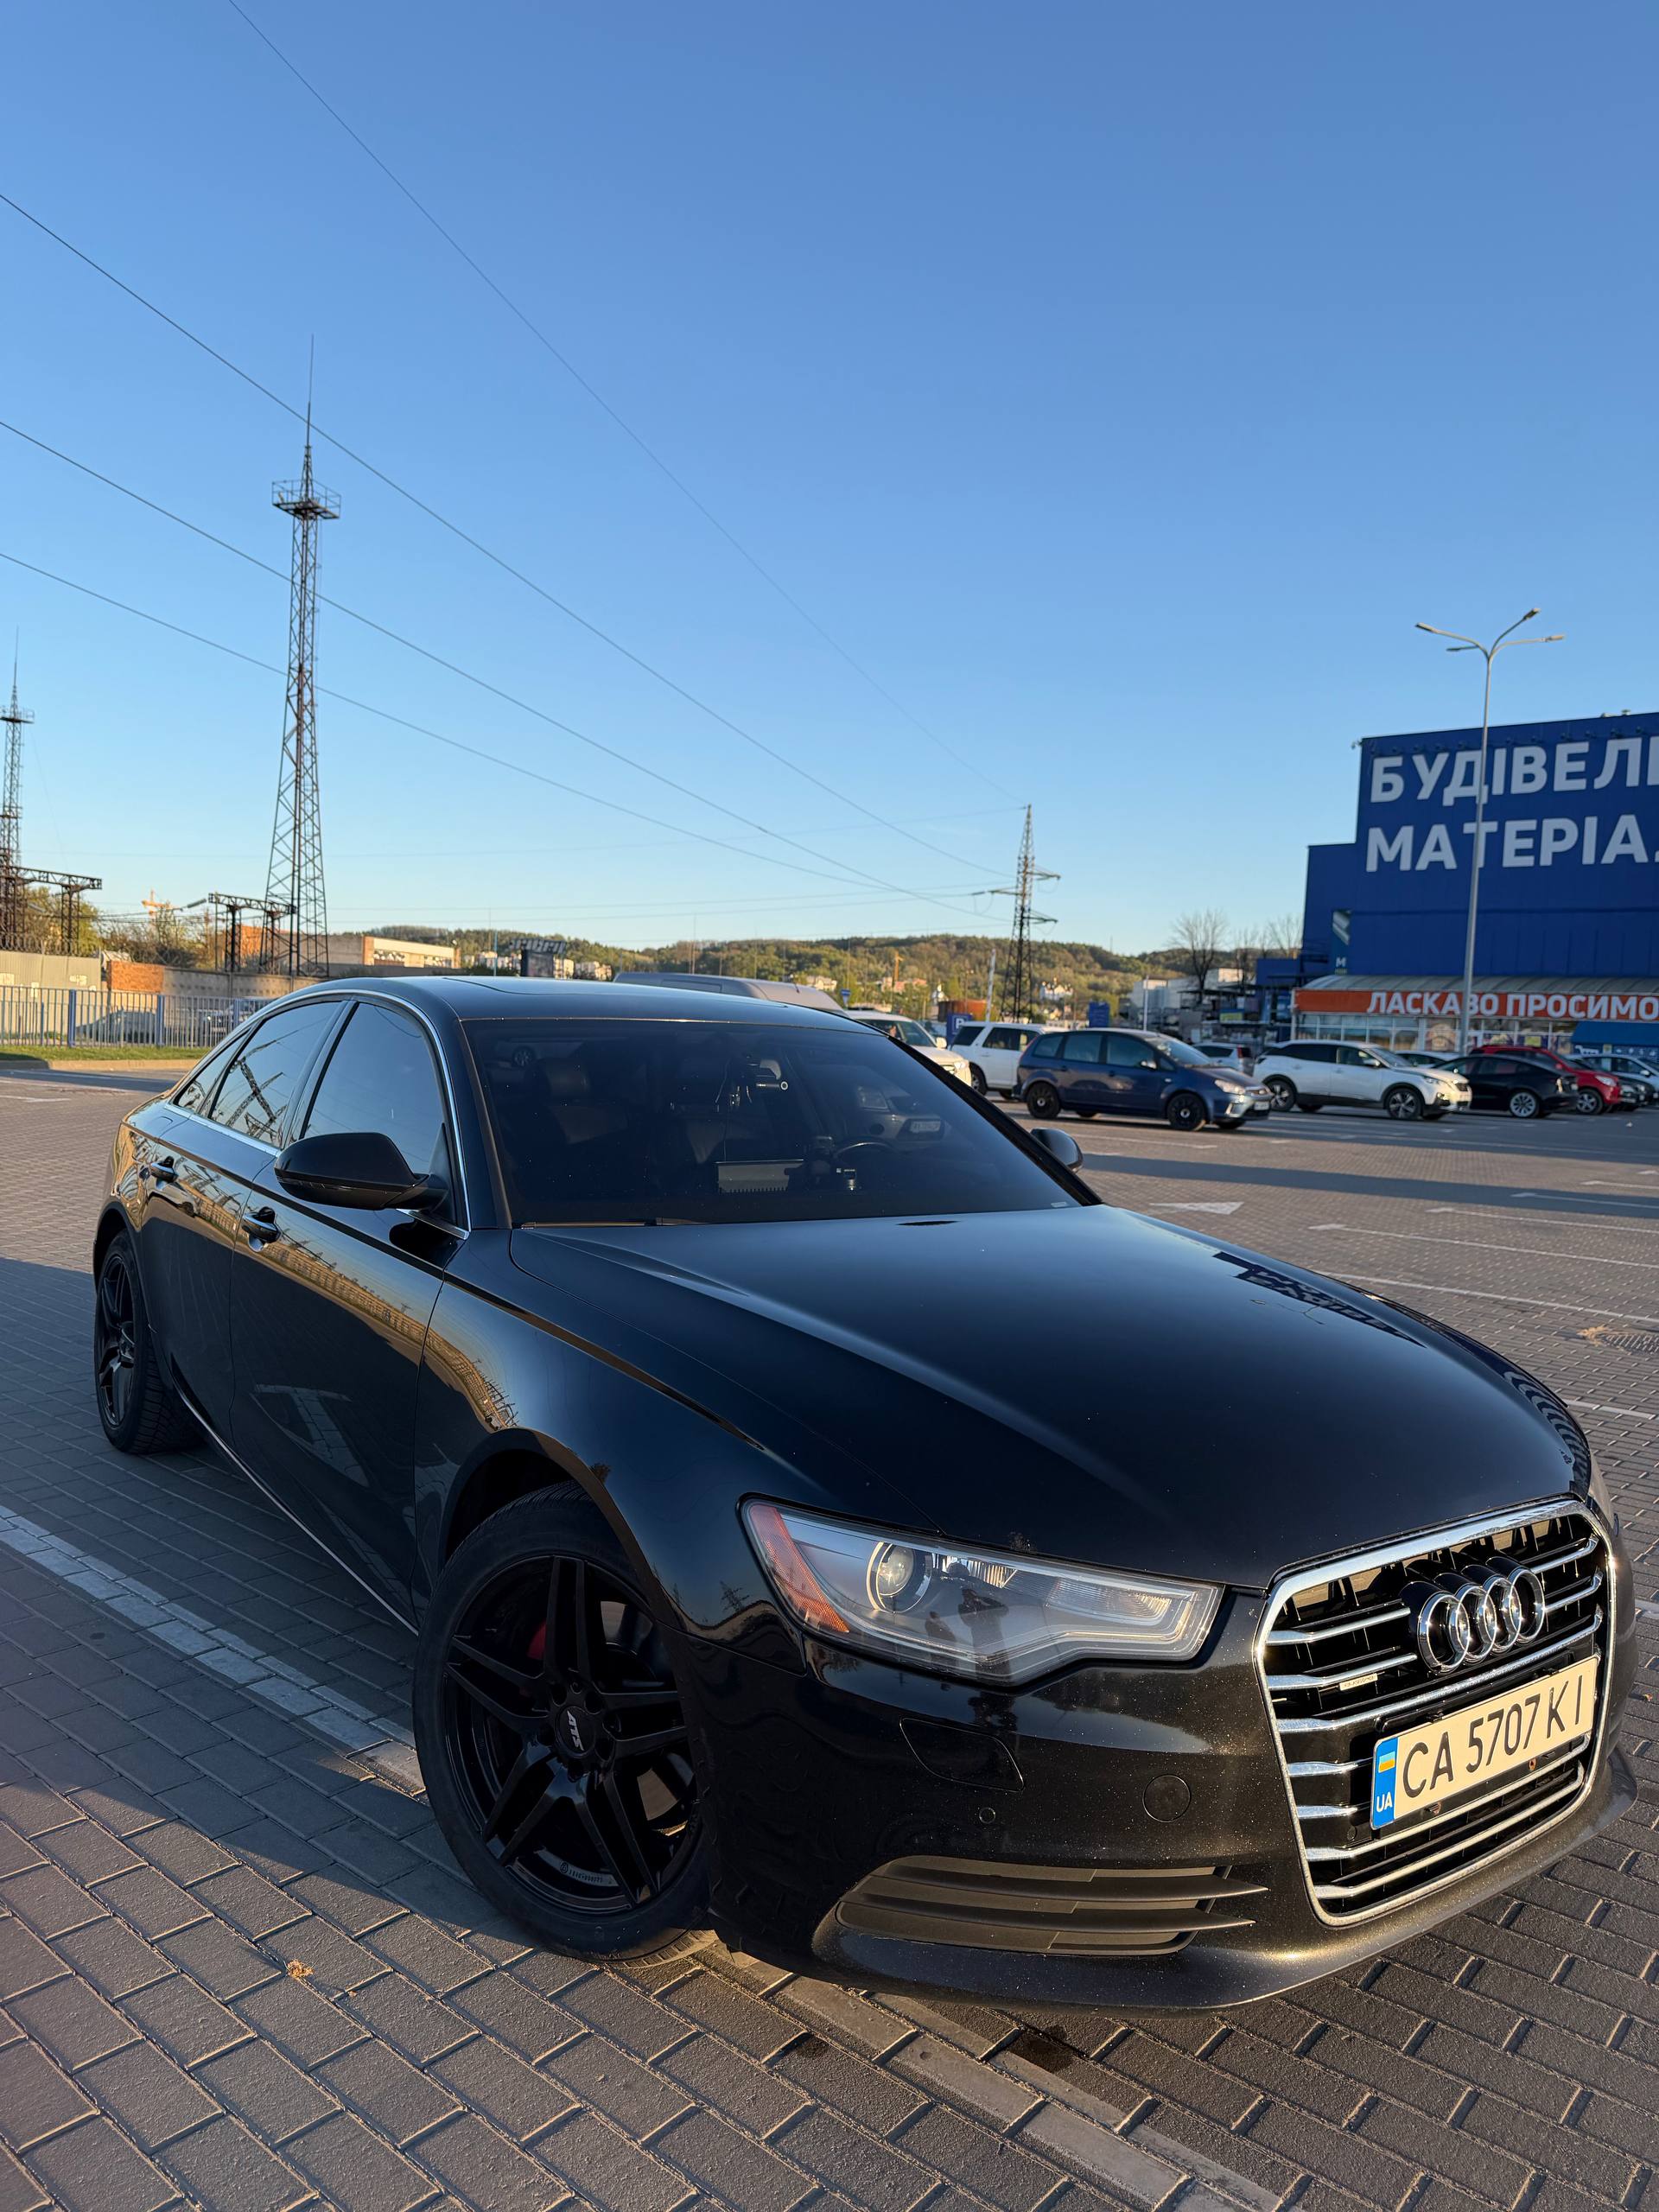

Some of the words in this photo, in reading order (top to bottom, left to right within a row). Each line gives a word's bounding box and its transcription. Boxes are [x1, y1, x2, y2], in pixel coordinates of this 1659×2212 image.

[1366, 814, 1659, 872] МАТЕРІА
[1367, 991, 1499, 1016] ЛАСКАВО
[1506, 994, 1659, 1020] ПРОСИМО
[1402, 1731, 1454, 1798] CA
[1465, 1694, 1541, 1773] 5707
[1547, 1675, 1583, 1738] KI
[1376, 1793, 1393, 1813] UA
